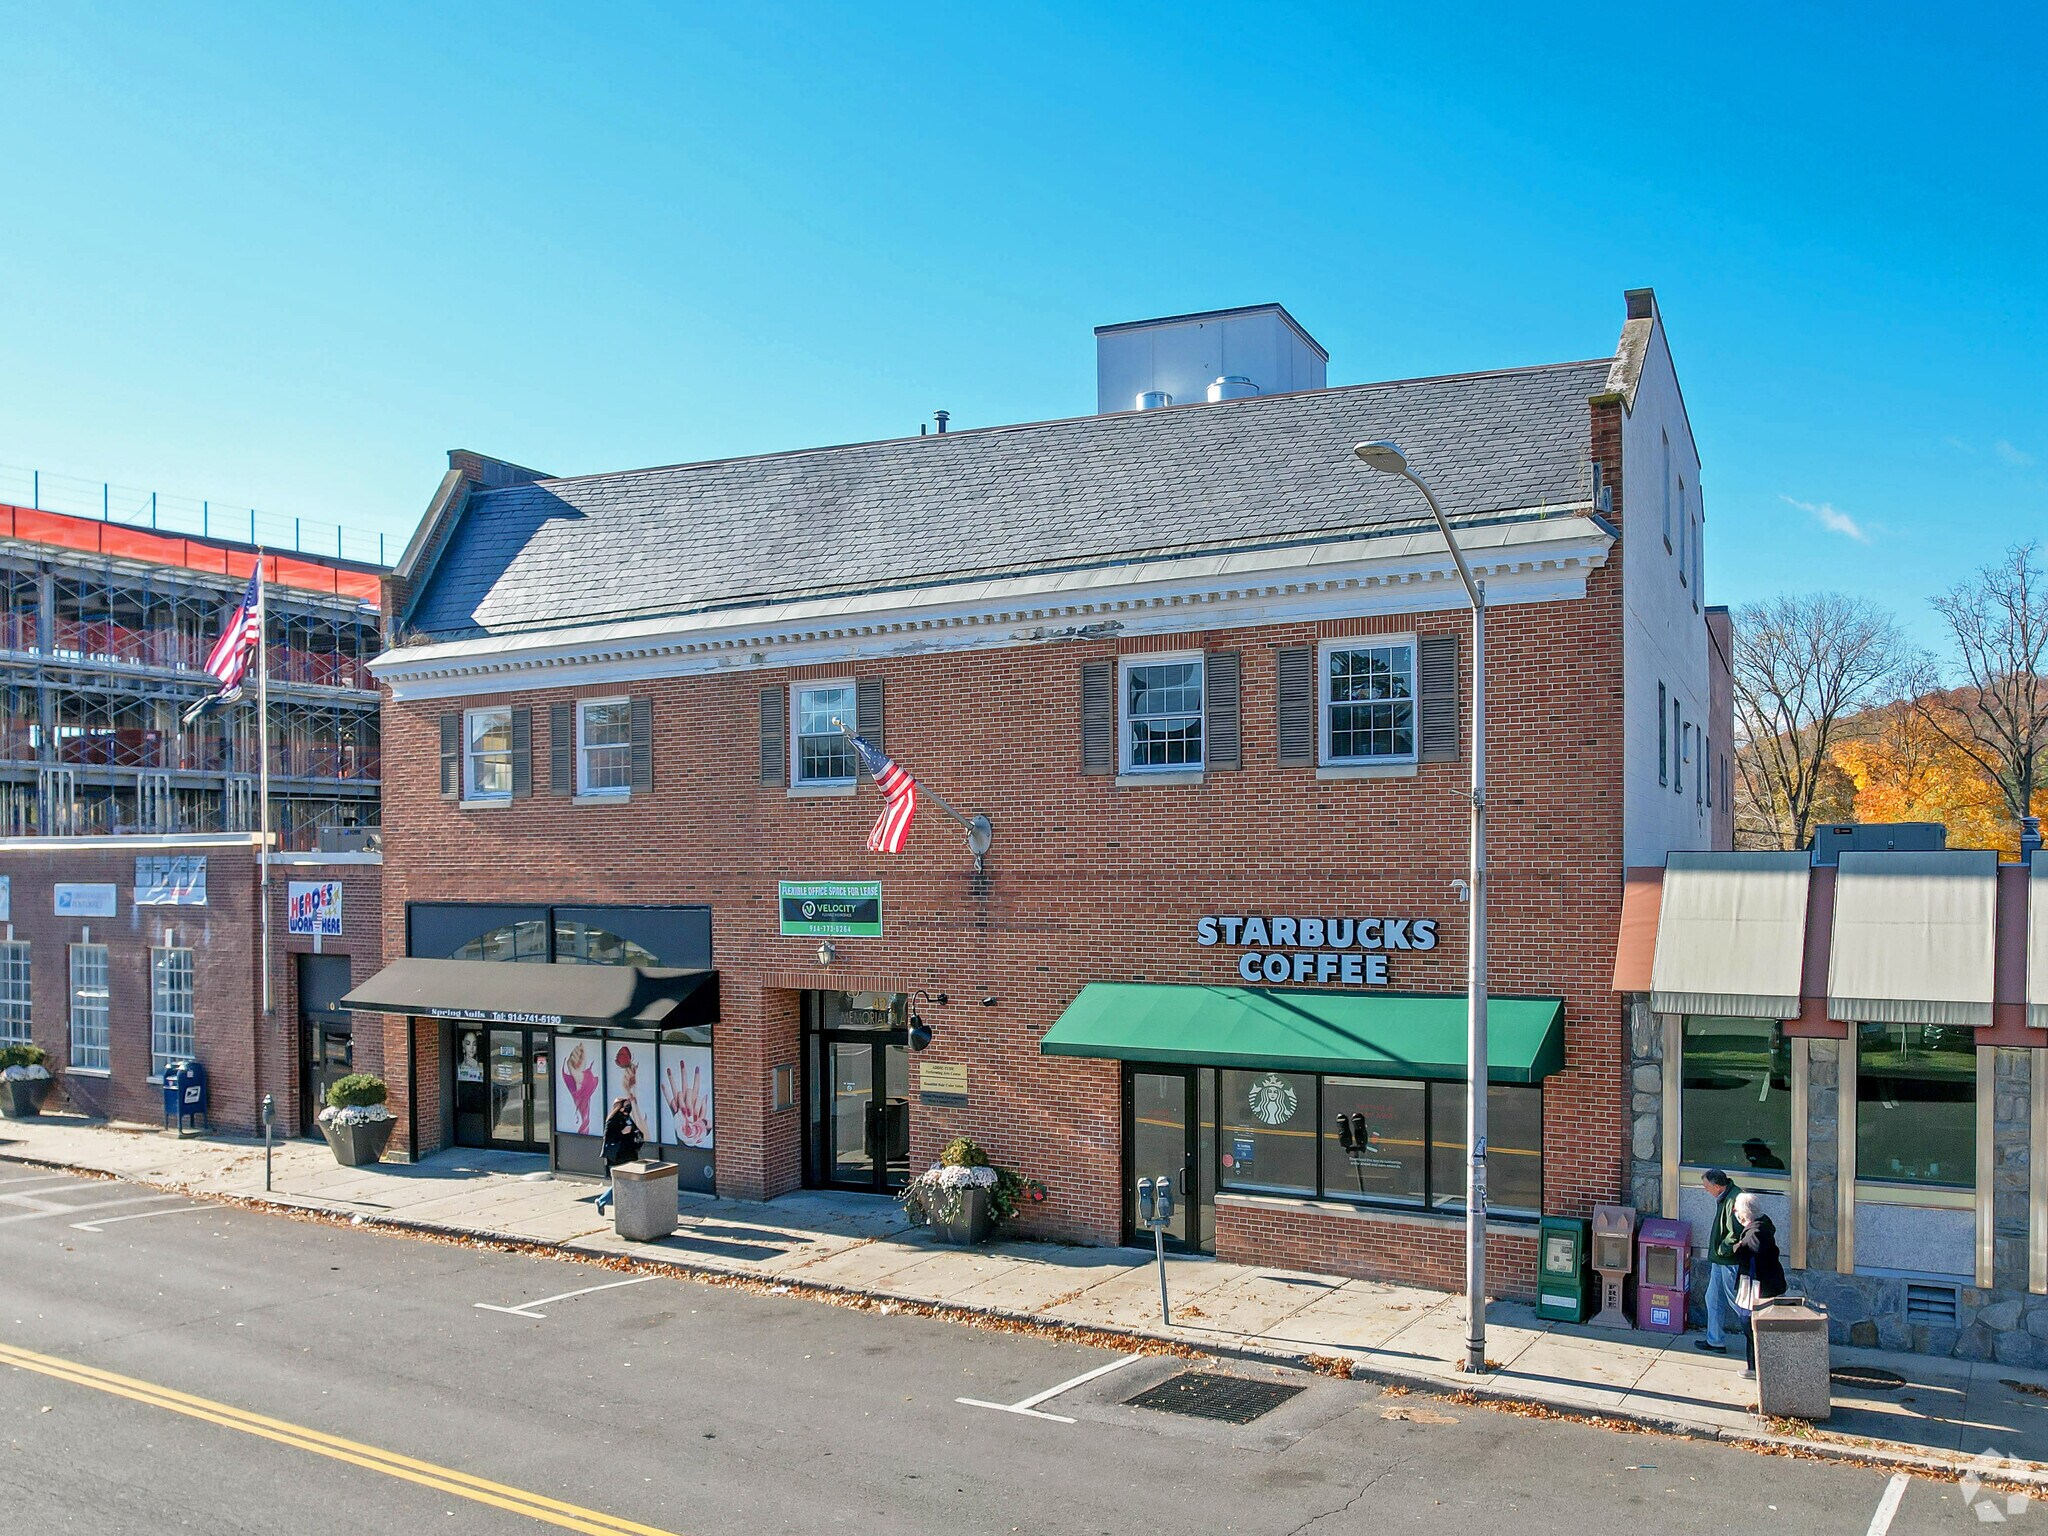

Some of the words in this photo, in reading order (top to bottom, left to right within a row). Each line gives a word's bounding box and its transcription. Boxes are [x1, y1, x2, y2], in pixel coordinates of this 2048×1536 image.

[782, 886, 807, 895] FLEXIBLE
[808, 886, 827, 896] OFFICE
[829, 887, 847, 896] SPACE
[848, 887, 859, 896] FOR
[860, 886, 878, 896] LEASE
[291, 884, 333, 918] HEROES
[816, 904, 857, 913] VELOCITY
[290, 917, 314, 932] WORK
[321, 918, 340, 933] HERE
[1197, 916, 1438, 950] STARBUCKS
[1238, 952, 1389, 985] COFFEE
[872, 997, 887, 1011] 42
[431, 1008, 461, 1017] Spring
[464, 1010, 486, 1018] Nails
[507, 1013, 561, 1024] 914-741-6190
[840, 1010, 886, 1025] MEMORIAL
